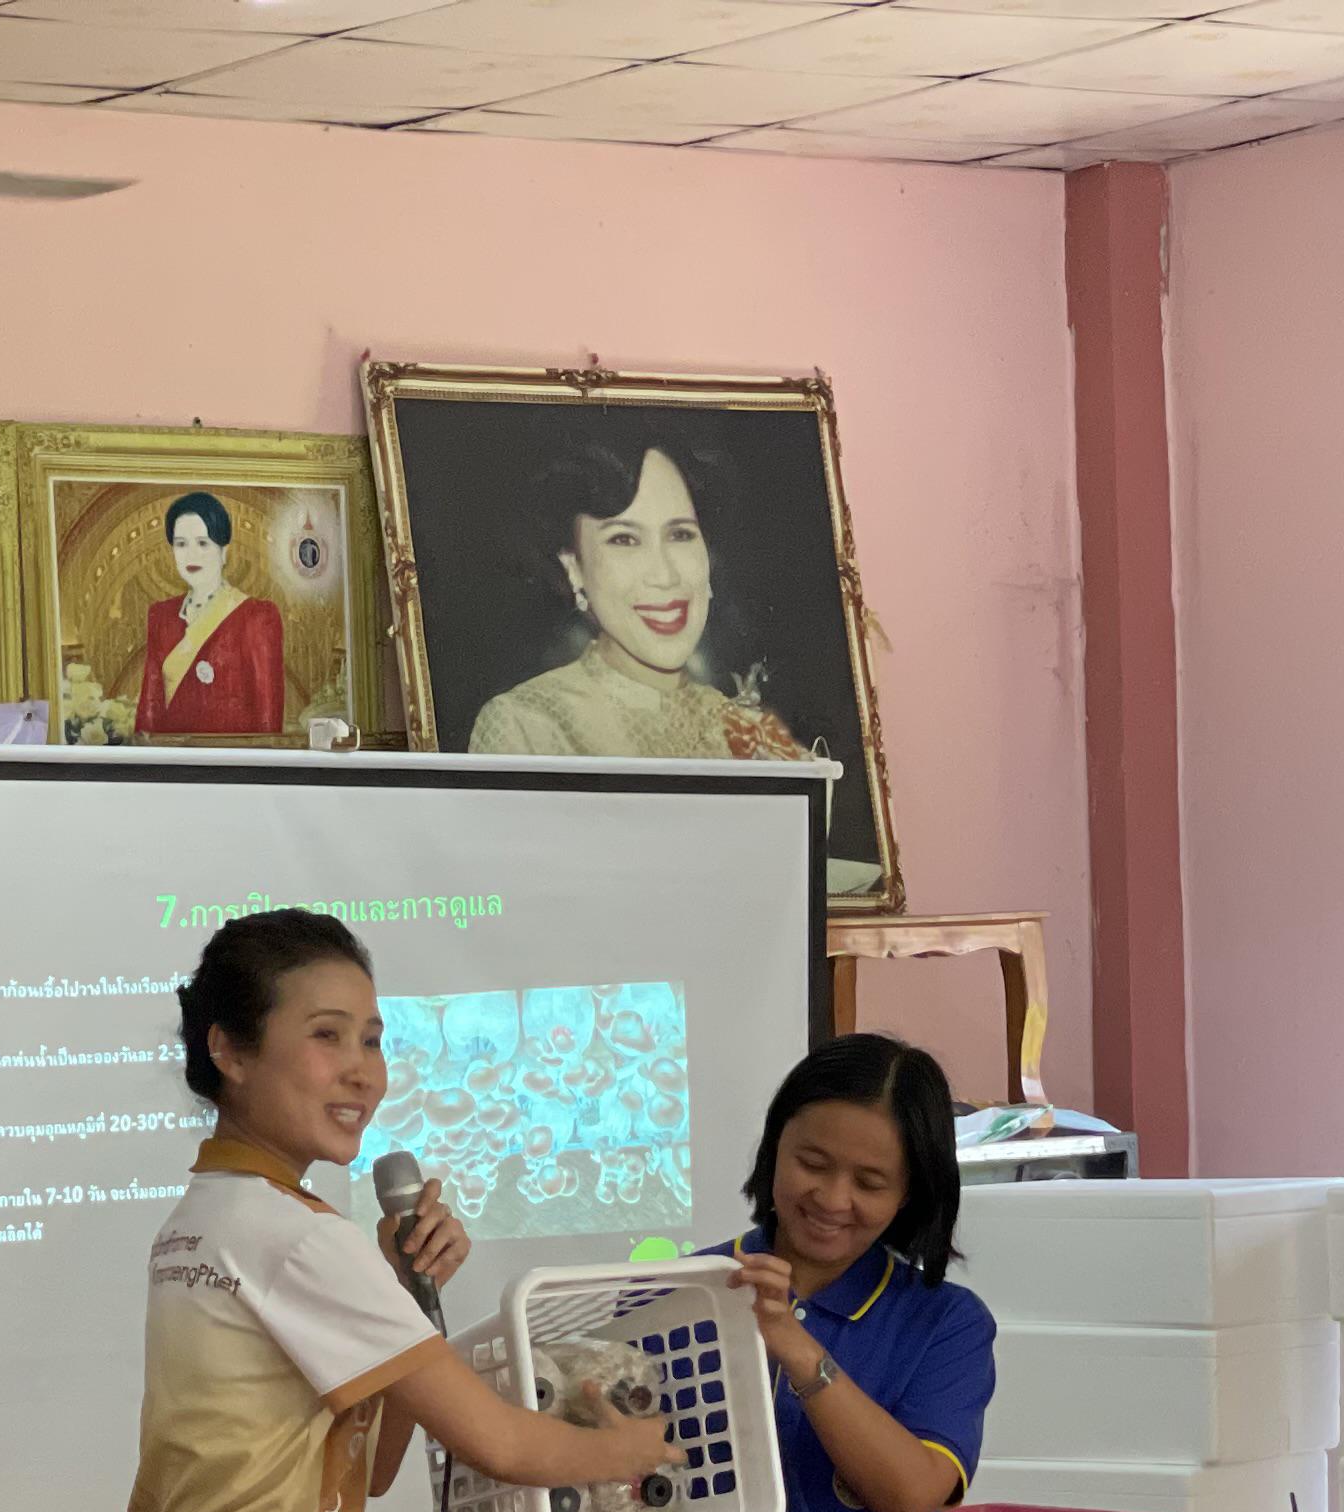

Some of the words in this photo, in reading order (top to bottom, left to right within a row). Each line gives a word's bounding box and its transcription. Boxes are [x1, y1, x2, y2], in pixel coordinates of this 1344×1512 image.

[109, 1111, 176, 1133] 20-30°C
[45, 1185, 83, 1205] 7-10
[88, 1184, 106, 1202] วัน
[110, 1176, 190, 1201] จะเริ่มออกด
